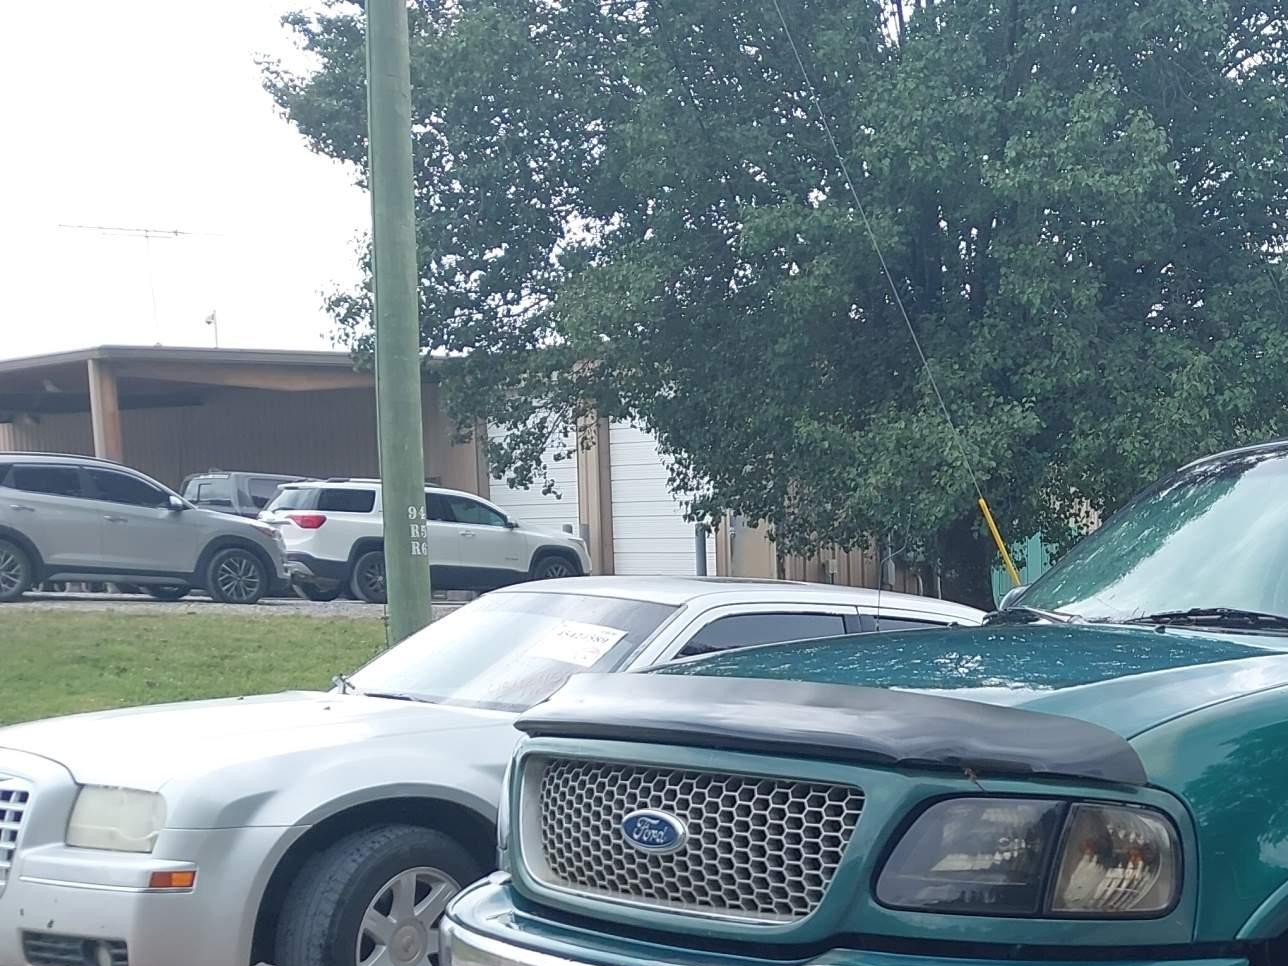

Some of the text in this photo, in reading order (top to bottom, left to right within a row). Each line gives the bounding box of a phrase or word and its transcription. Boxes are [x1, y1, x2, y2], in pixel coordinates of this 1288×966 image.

[408, 505, 426, 520] 94
[410, 524, 427, 538] R5
[411, 541, 428, 555] R6
[633, 816, 668, 843] Ford
